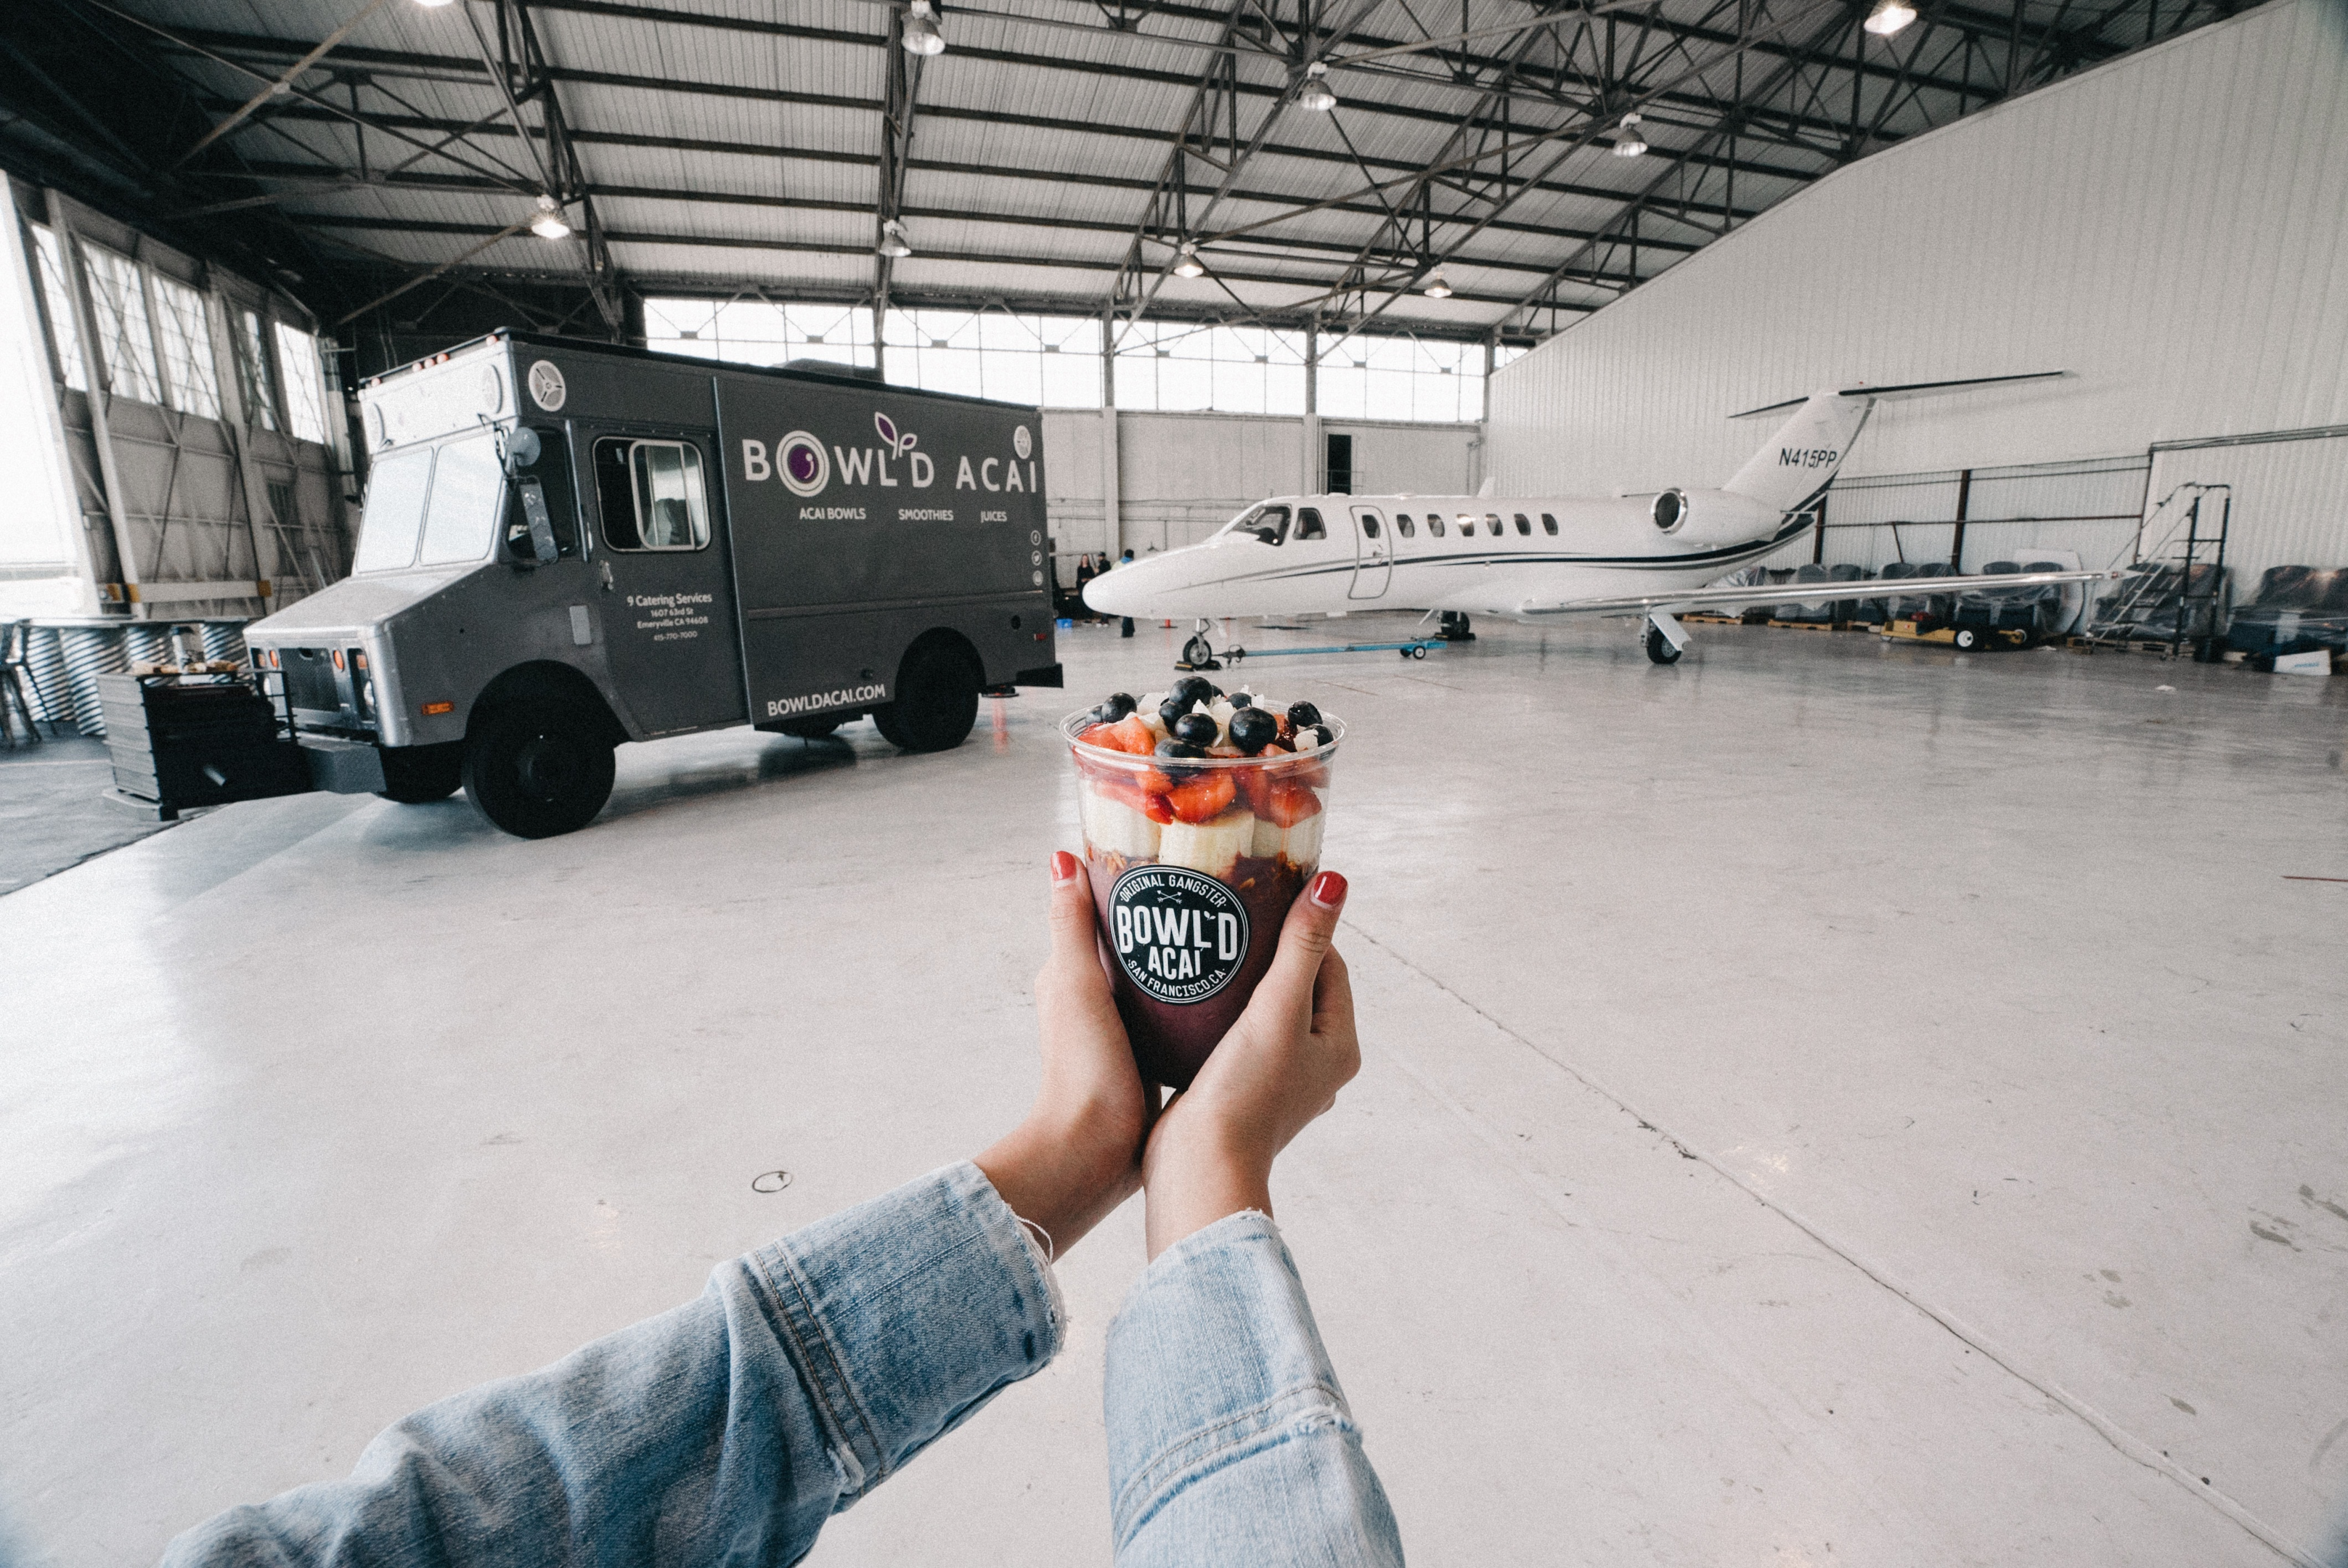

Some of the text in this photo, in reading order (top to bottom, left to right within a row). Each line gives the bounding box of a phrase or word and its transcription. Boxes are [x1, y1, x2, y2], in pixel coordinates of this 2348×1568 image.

[1779, 447, 1838, 468] N415PP
[955, 455, 1038, 493] ACAI
[799, 507, 1008, 523] ACAI BOWLS SMOOTHIES JUICES
[627, 593, 712, 608] 9 Catering Services
[767, 684, 885, 716] BOWLDACAI.COM
[1120, 873, 1227, 908] ORIGINAL GANGSTER
[1128, 960, 1148, 982] SAN
[1148, 945, 1201, 980] ACAI
